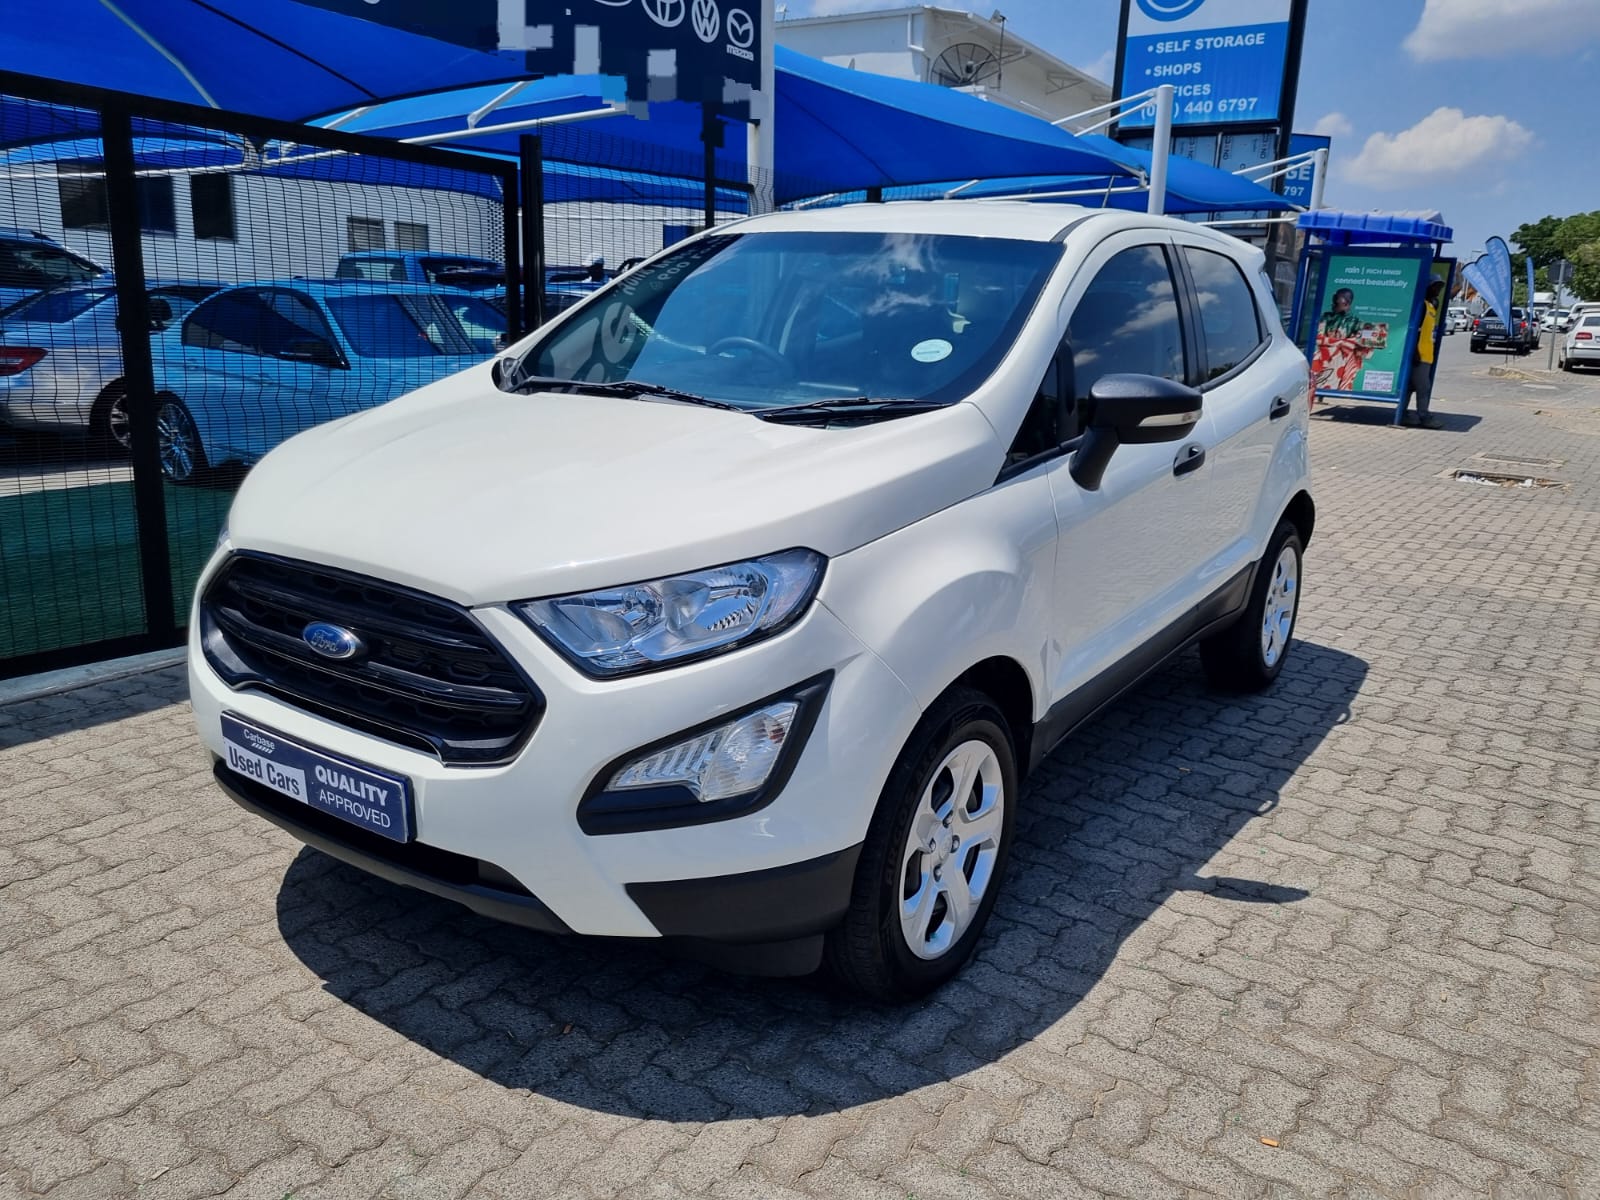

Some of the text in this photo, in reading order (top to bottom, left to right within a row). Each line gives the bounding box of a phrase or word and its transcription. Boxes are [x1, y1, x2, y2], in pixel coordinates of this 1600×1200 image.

[1155, 32, 1265, 54] SELF STORAGE
[1153, 62, 1202, 77] SHOPS
[1141, 97, 1258, 121] (0) 440 6797
[1366, 278, 1408, 288] beautifully
[311, 629, 341, 652] Ford
[243, 728, 275, 749] Carbase
[228, 745, 300, 796] Used Cars
[314, 764, 388, 807] QUALITY
[319, 789, 391, 829] APPROVED
